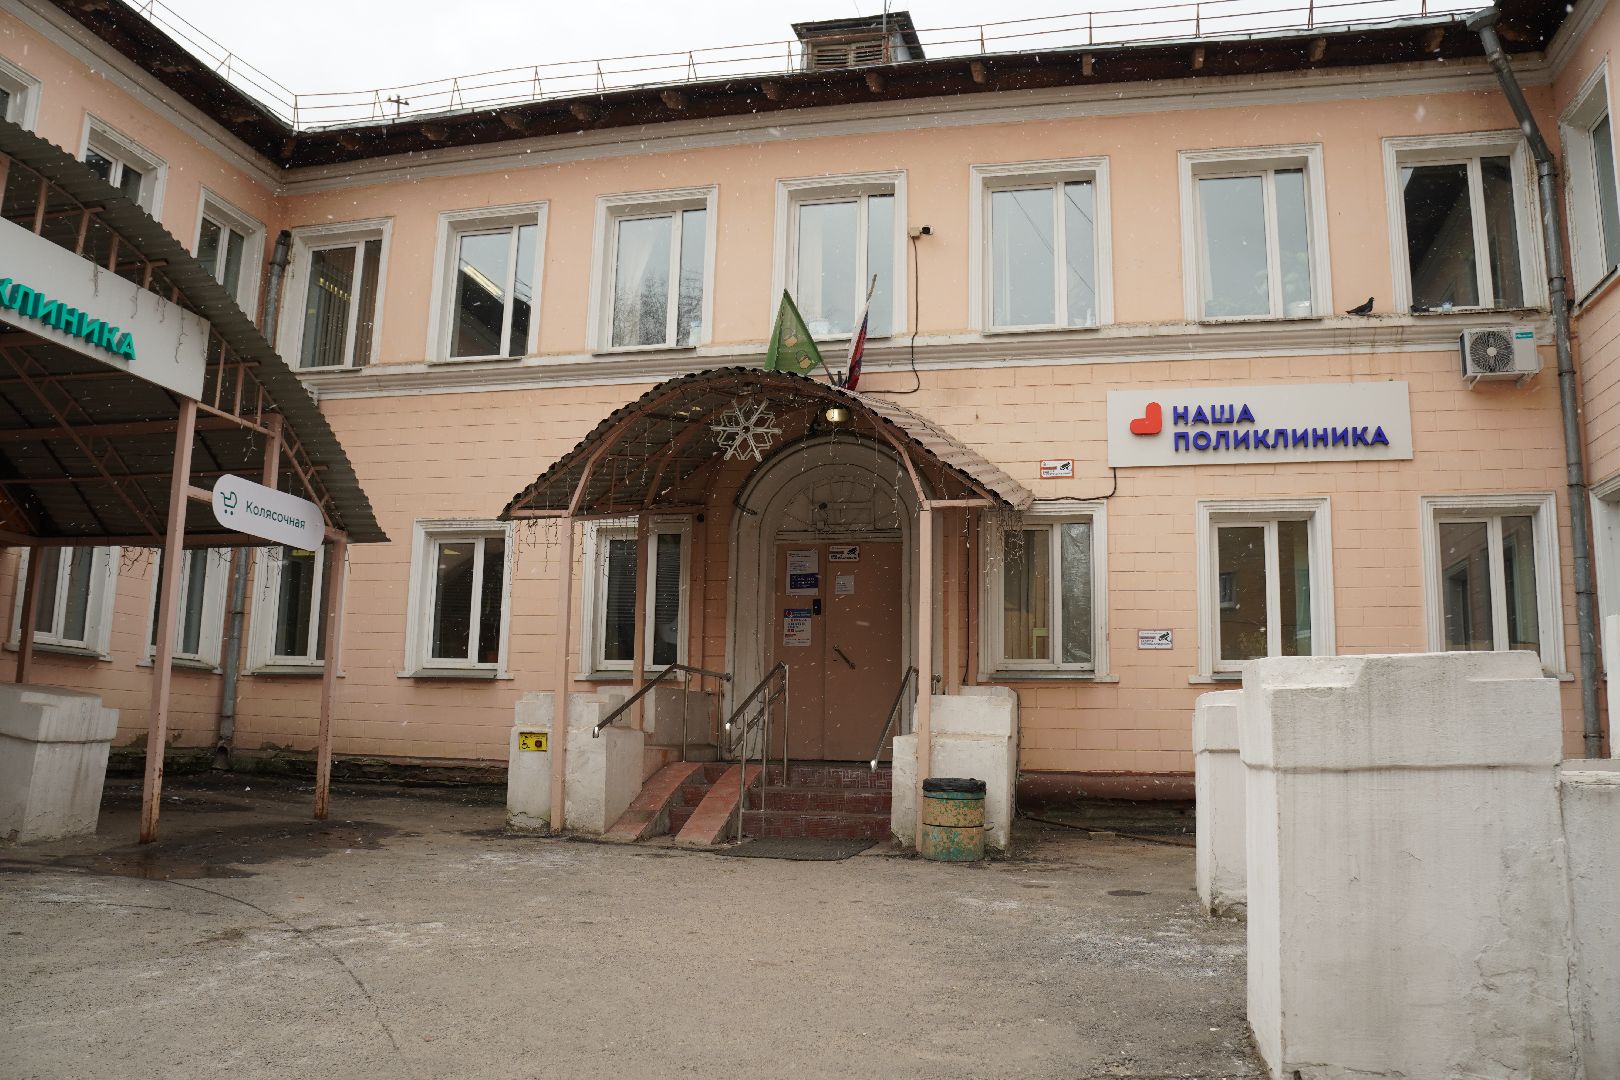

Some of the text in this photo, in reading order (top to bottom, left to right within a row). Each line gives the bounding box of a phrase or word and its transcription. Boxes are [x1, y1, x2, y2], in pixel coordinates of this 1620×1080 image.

[1173, 403, 1255, 425] НАША
[1174, 426, 1389, 451] ПОЛИКЛИНИКА
[246, 500, 306, 530] Колясочная
